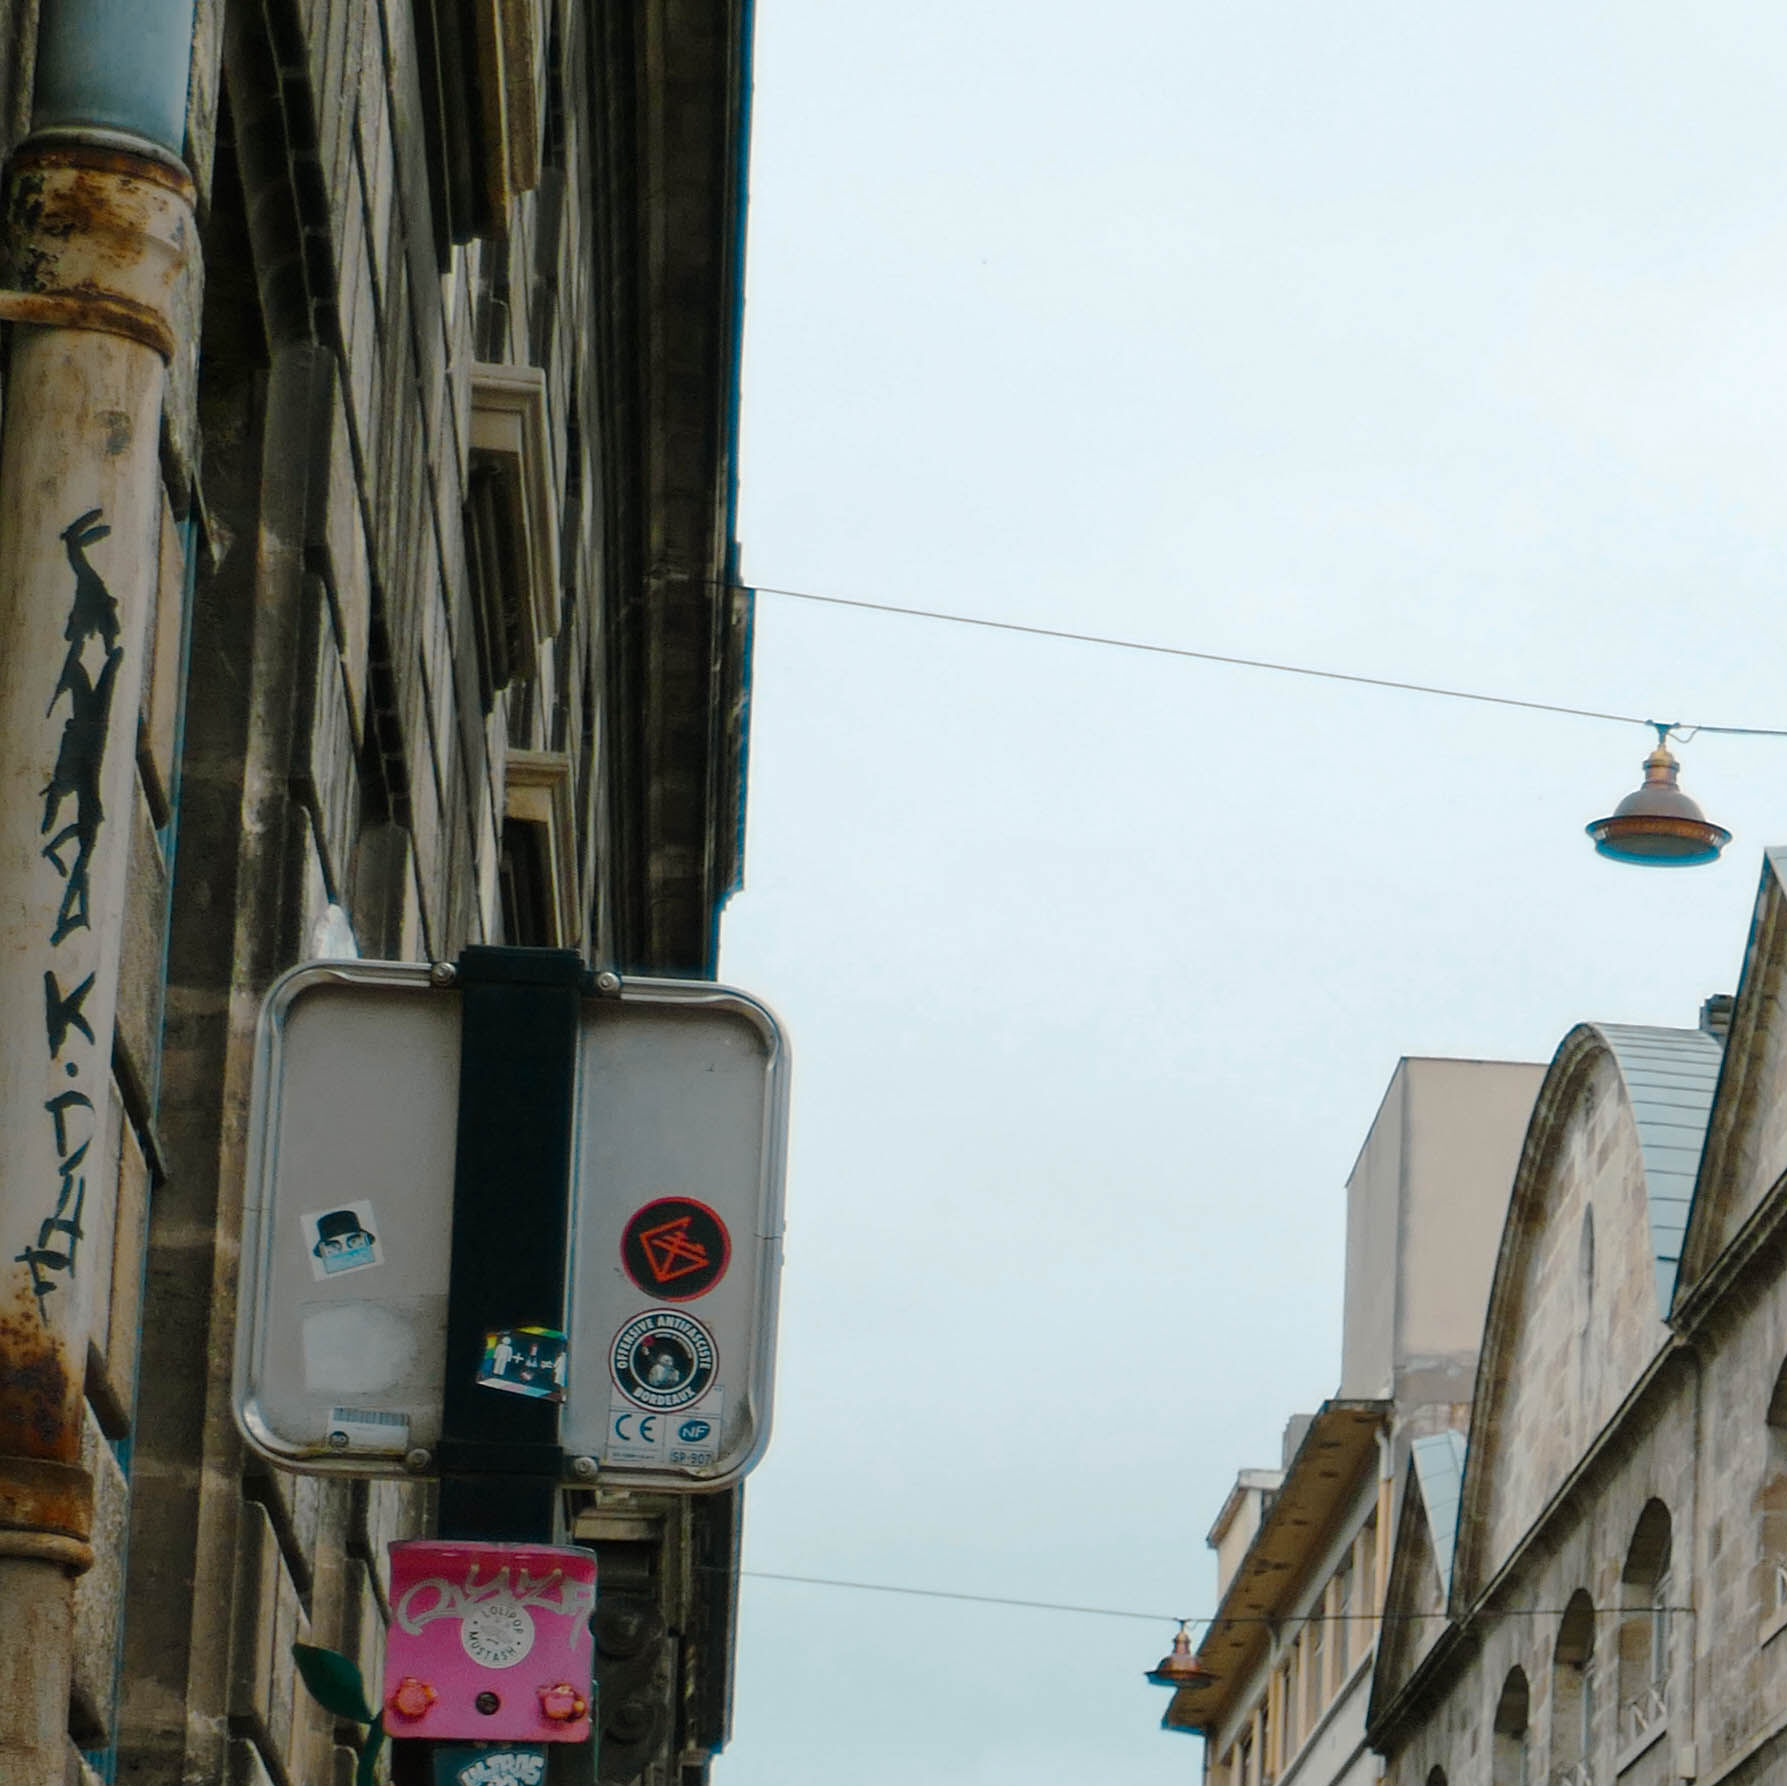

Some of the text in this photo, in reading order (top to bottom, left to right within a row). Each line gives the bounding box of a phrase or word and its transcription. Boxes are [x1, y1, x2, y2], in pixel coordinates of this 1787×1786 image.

[616, 1315, 655, 1370] OFFENSIVE
[632, 1385, 697, 1407] BORDEAUX
[614, 1413, 657, 1443] CE
[681, 1426, 709, 1439] NF
[468, 1630, 515, 1662] MUSTASH
